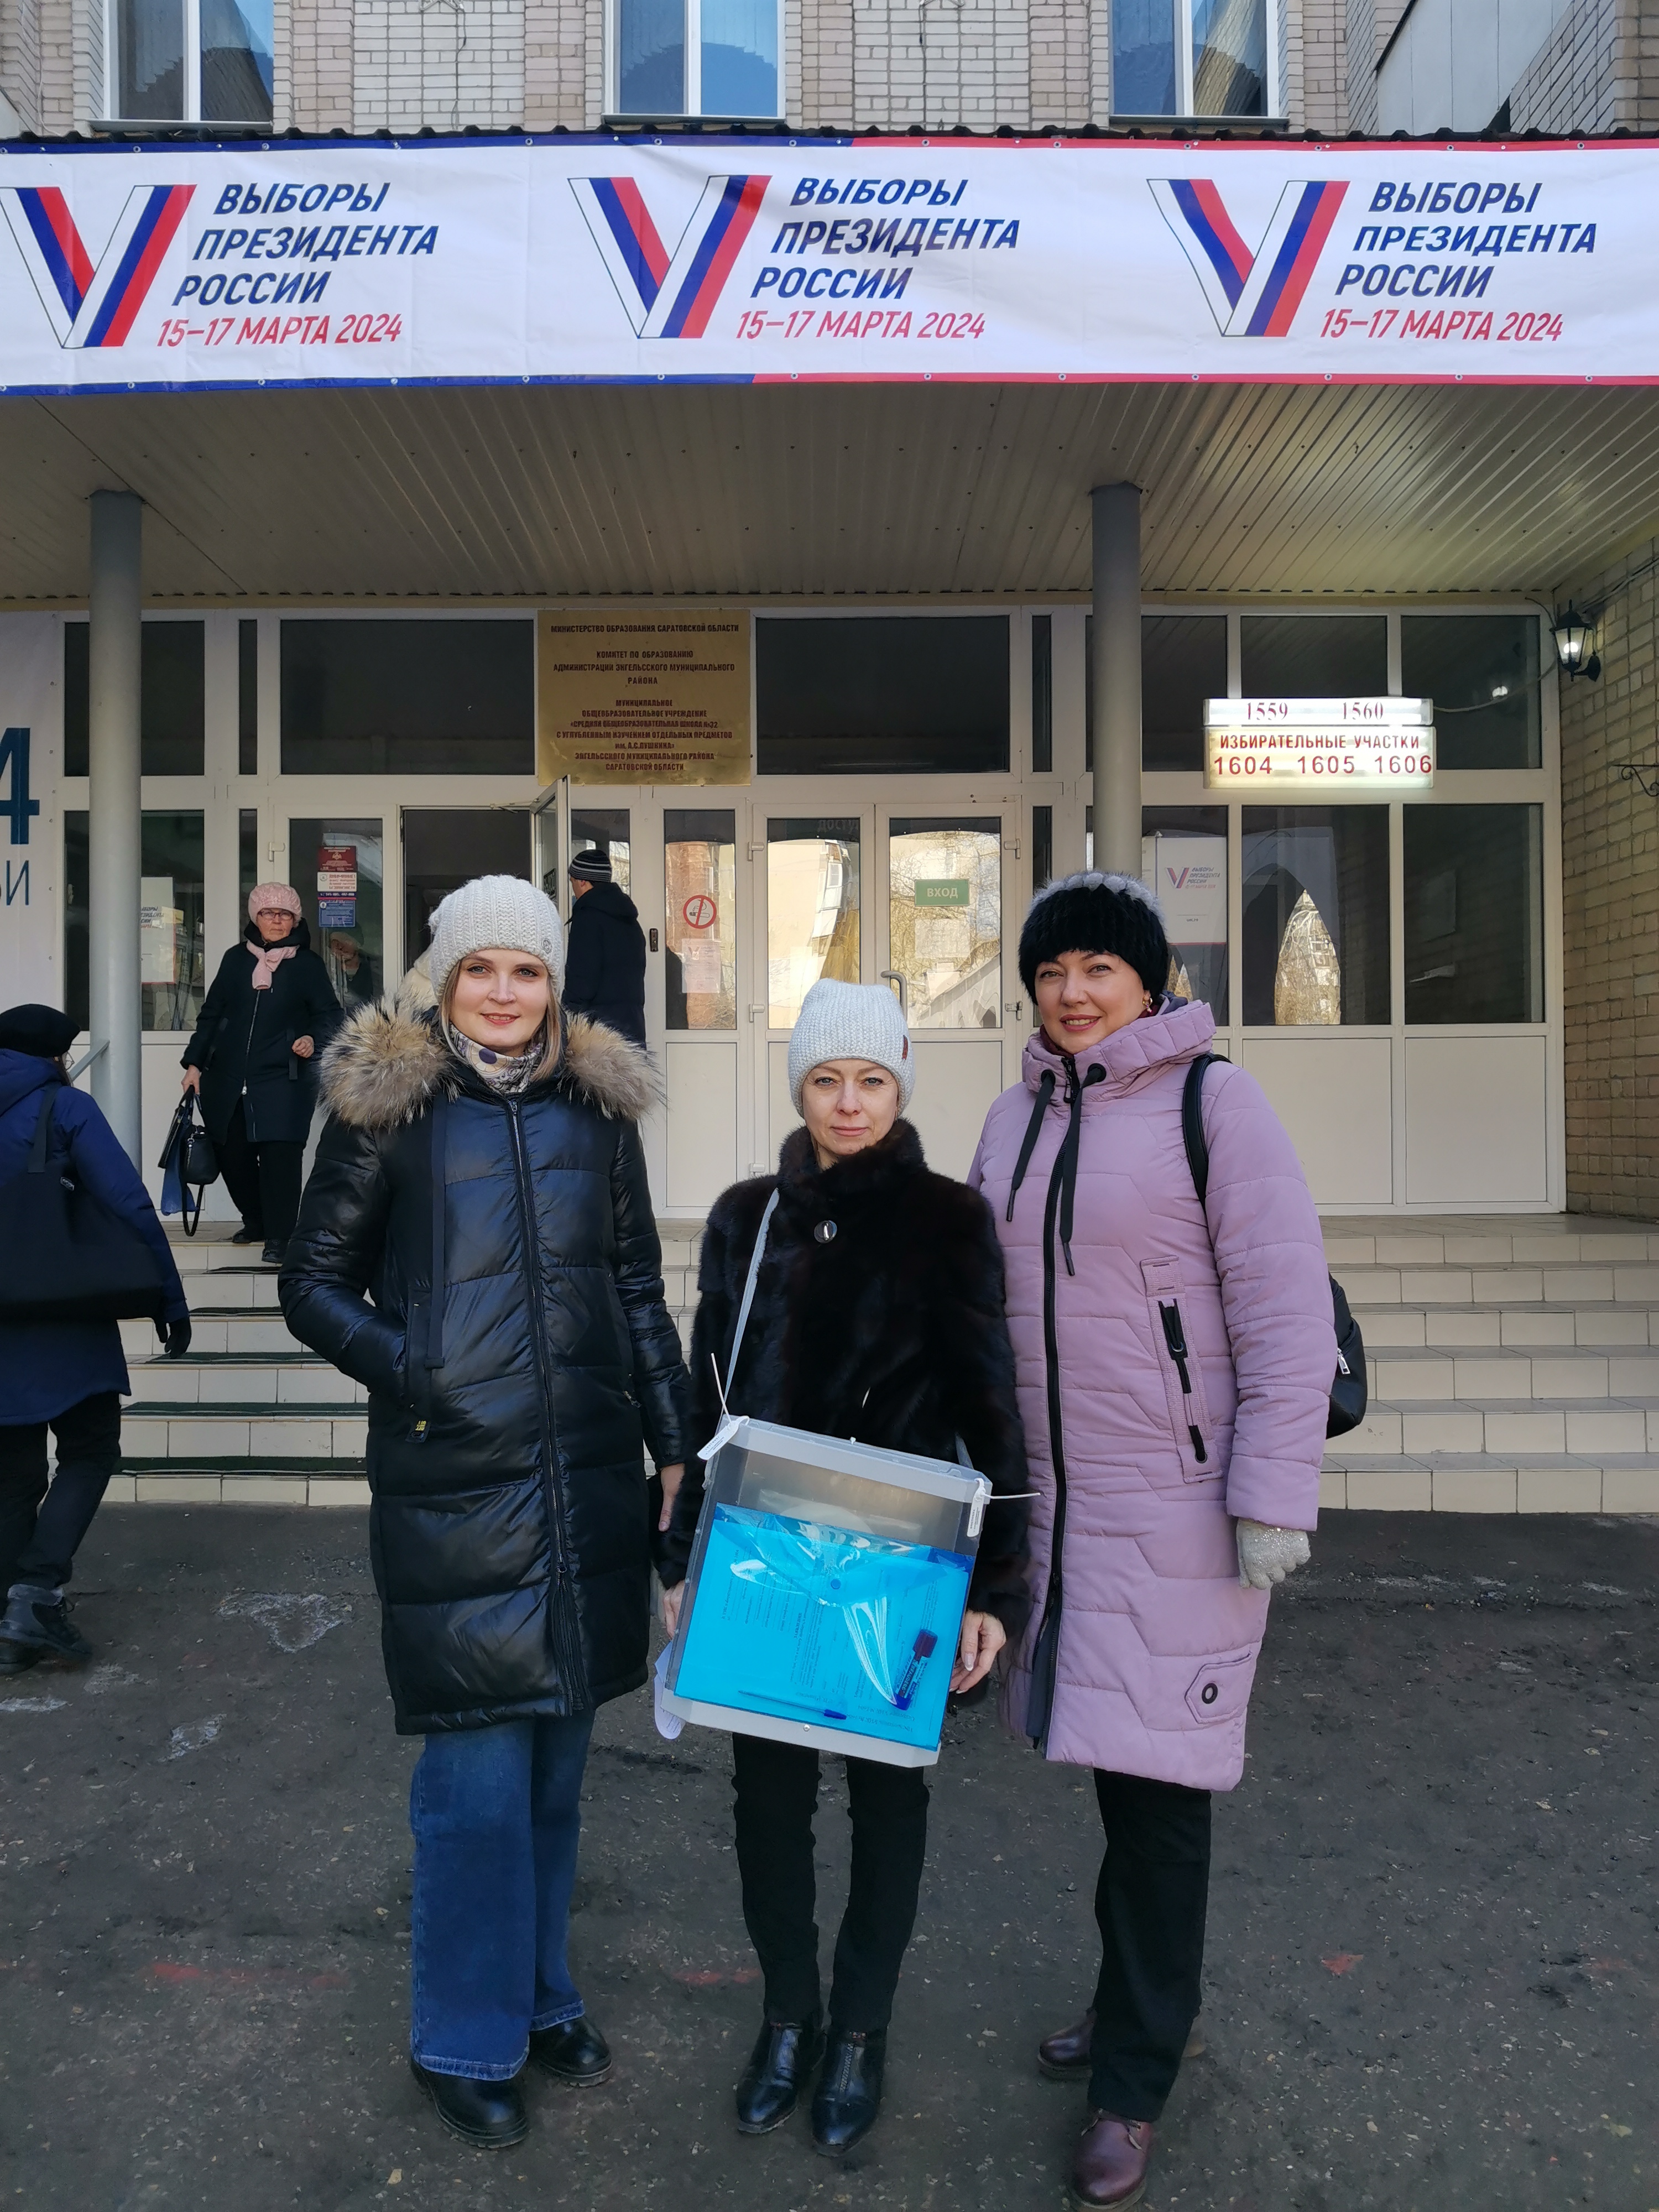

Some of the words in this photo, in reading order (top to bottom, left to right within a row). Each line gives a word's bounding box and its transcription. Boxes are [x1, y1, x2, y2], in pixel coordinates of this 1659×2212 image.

[214, 182, 391, 215] ВЫБОРЫ
[789, 177, 969, 207] ВЫБОРЫ
[1368, 181, 1542, 213] ВЫБОРЫ
[192, 225, 439, 263] ПРЕЗИДЕНТА
[770, 217, 1020, 259] ПРЕЗИДЕНТА
[1352, 223, 1597, 257] ПРЕЗИДЕНТА
[173, 271, 331, 306] РОССИИ
[750, 267, 913, 300] РОССИИ
[1334, 264, 1494, 298] РОССИИ
[235, 315, 331, 346] МАРТА
[335, 314, 403, 345] 2024
[817, 311, 913, 339] МАРТА
[917, 312, 986, 340] 2024
[1399, 310, 1493, 341] МАРТА
[1496, 312, 1564, 341] 2024
[551, 624, 604, 633] МИНИСТЕРСТВО
[606, 624, 655, 633] ОБРАЗОВАНИЯ
[658, 623, 706, 633] САРАТОВСКОЙ
[553, 664, 614, 672] АДМИНИСТРАЦИИ
[670, 664, 735, 672] МУНИЦИПАЛЬНОГО
[628, 675, 658, 684] РАЙОНА
[1246, 702, 1288, 721] 1559
[1342, 701, 1384, 721] 1560
[689, 751, 714, 760] РАЙОНА
[1220, 734, 1347, 749] ИЗБИРАТЕЛЬНЫЕ
[1354, 735, 1420, 749] УЧАСТКИ
[606, 762, 653, 770] САРАТОВСКОЙ
[1214, 756, 1272, 775] 1604
[1297, 755, 1355, 775] 1605
[1374, 755, 1432, 774] 1606
[0, 860, 29, 906] И
[927, 888, 958, 899] ВХОД
